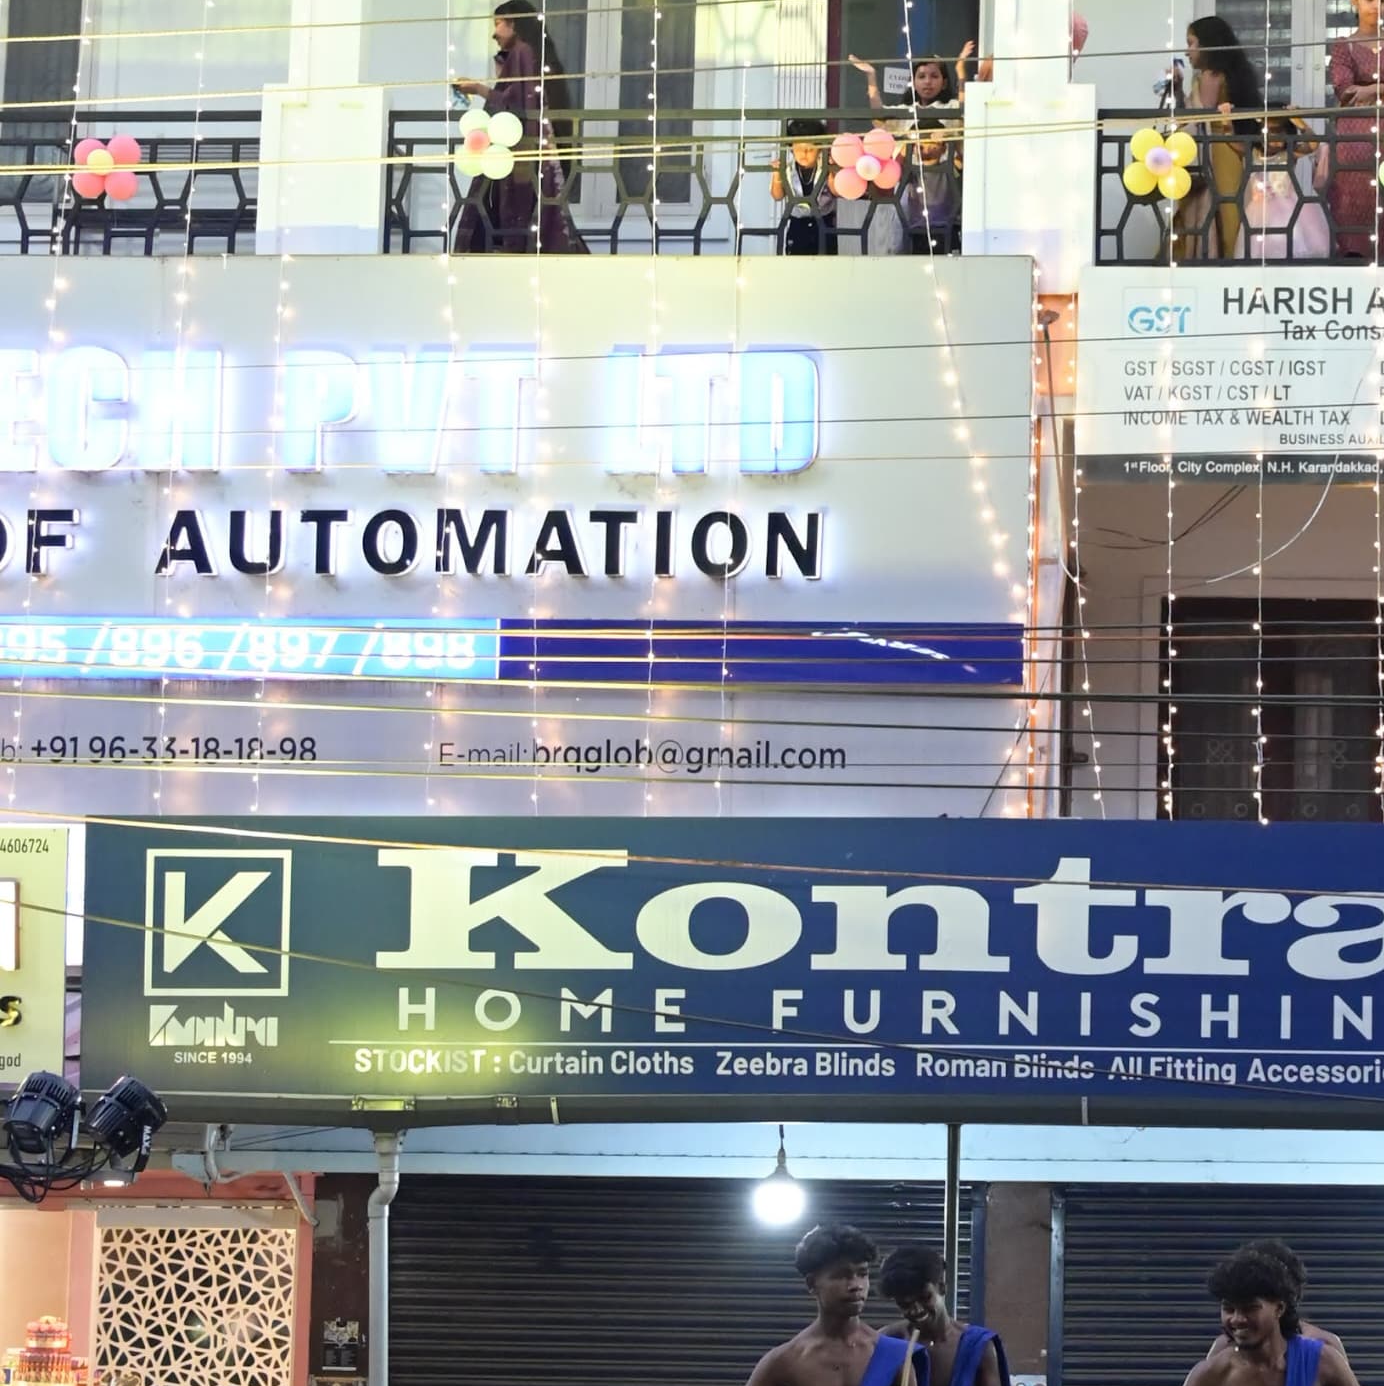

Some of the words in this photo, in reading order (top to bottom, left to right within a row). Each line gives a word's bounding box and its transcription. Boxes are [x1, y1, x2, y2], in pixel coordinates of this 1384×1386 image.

[1223, 286, 1352, 315] HARISH
[1127, 305, 1191, 335] GST
[1280, 319, 1317, 341] Tax
[1124, 360, 1158, 377] GST
[1171, 360, 1215, 377] SGST
[1229, 360, 1275, 377] CGST
[1288, 360, 1327, 377] IGST
[1124, 385, 1154, 402] VAT
[1168, 385, 1214, 402] KGST
[1226, 385, 1259, 401] CST
[1273, 385, 1292, 401] LT
[283, 344, 539, 475] PVT
[605, 344, 823, 475] LTD
[1124, 410, 1188, 426] INCOME
[1195, 410, 1224, 426] TAX
[1229, 411, 1240, 426] &
[1246, 410, 1314, 426] WEALTH
[1320, 410, 1351, 425] TAX
[1279, 433, 1345, 445] BUSINESS
[1178, 461, 1201, 476] City
[1267, 461, 1295, 474] N.H.
[0, 507, 81, 576] F
[154, 507, 824, 579] AUTOMATION
[0, 627, 66, 662] 95
[533, 738, 847, 775] brqglob@gmail.com
[162, 870, 273, 975] K
[398, 987, 687, 1034] HOME
[173, 1050, 217, 1065] SINCE
[221, 1051, 253, 1065] 1994
[354, 1048, 487, 1074] STOCKIST
[509, 1049, 603, 1076] Curtain
[610, 1049, 694, 1077] Cloths
[716, 1050, 809, 1077] Zeebra
[815, 1051, 896, 1078] Blinds
[916, 1052, 1007, 1079] Roman
[1014, 1054, 1094, 1080] Blinds
[1107, 1056, 1143, 1081] All
[1149, 1056, 1238, 1087] Fitting
